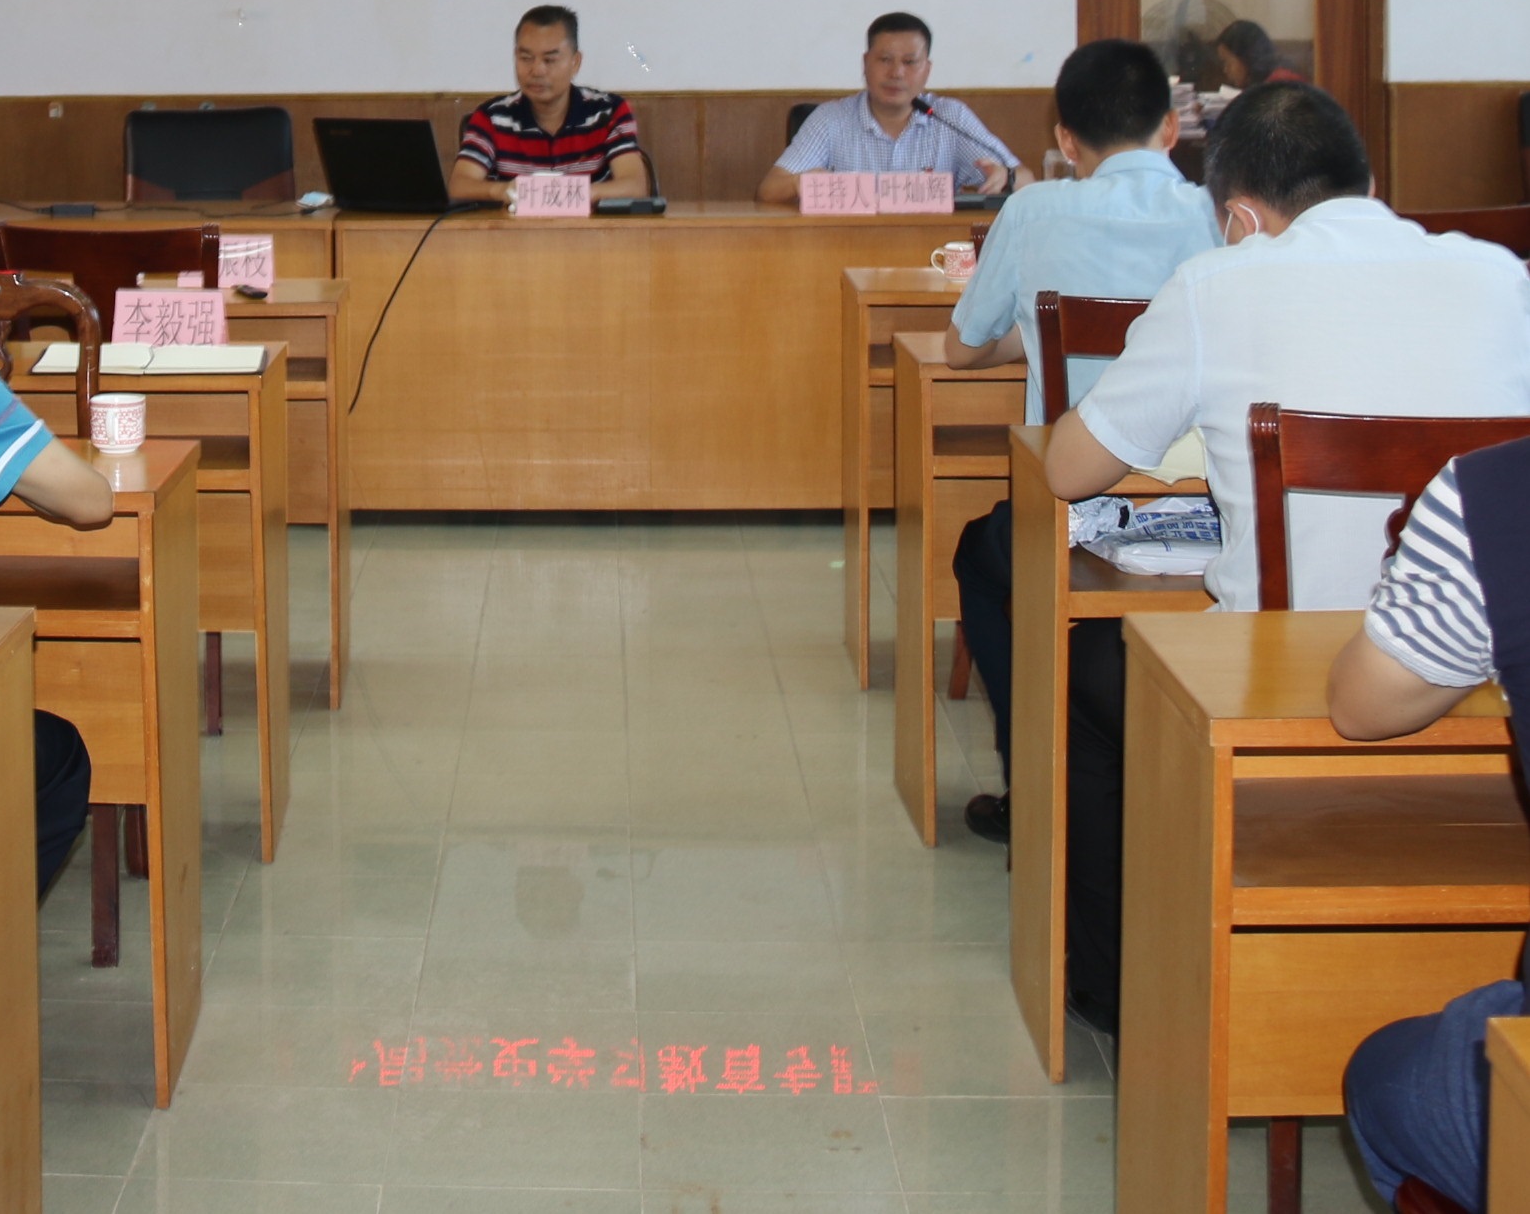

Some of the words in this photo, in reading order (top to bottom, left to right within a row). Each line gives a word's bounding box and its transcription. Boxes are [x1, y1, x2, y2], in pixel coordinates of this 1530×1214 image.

[518, 176, 585, 209] 叶成林
[805, 175, 870, 210] 主持人
[123, 298, 215, 347] 李毅强
